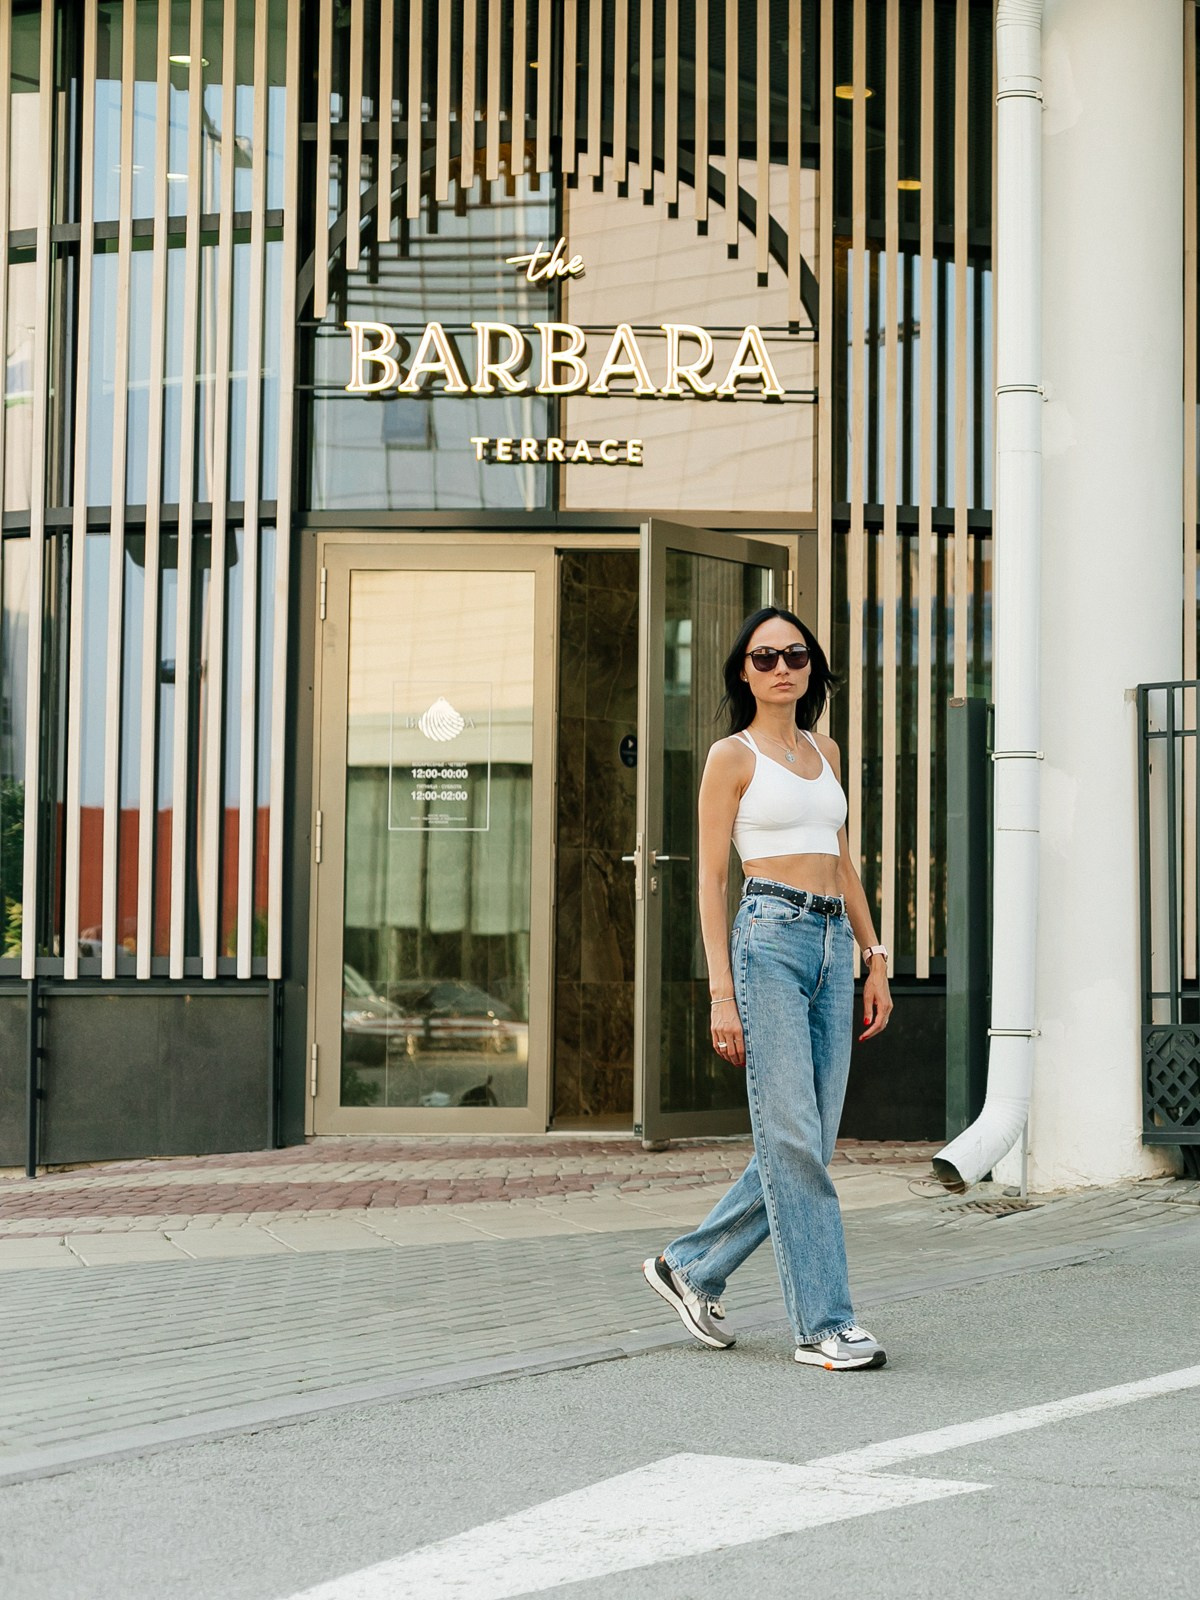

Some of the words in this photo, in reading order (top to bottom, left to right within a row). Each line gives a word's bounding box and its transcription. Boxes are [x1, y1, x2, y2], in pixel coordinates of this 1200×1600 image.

[506, 236, 585, 282] the
[344, 321, 785, 395] BARBARA
[471, 436, 643, 463] TERRACE
[411, 768, 468, 779] 12:00-00:00
[411, 790, 468, 801] 12:00-02:00
